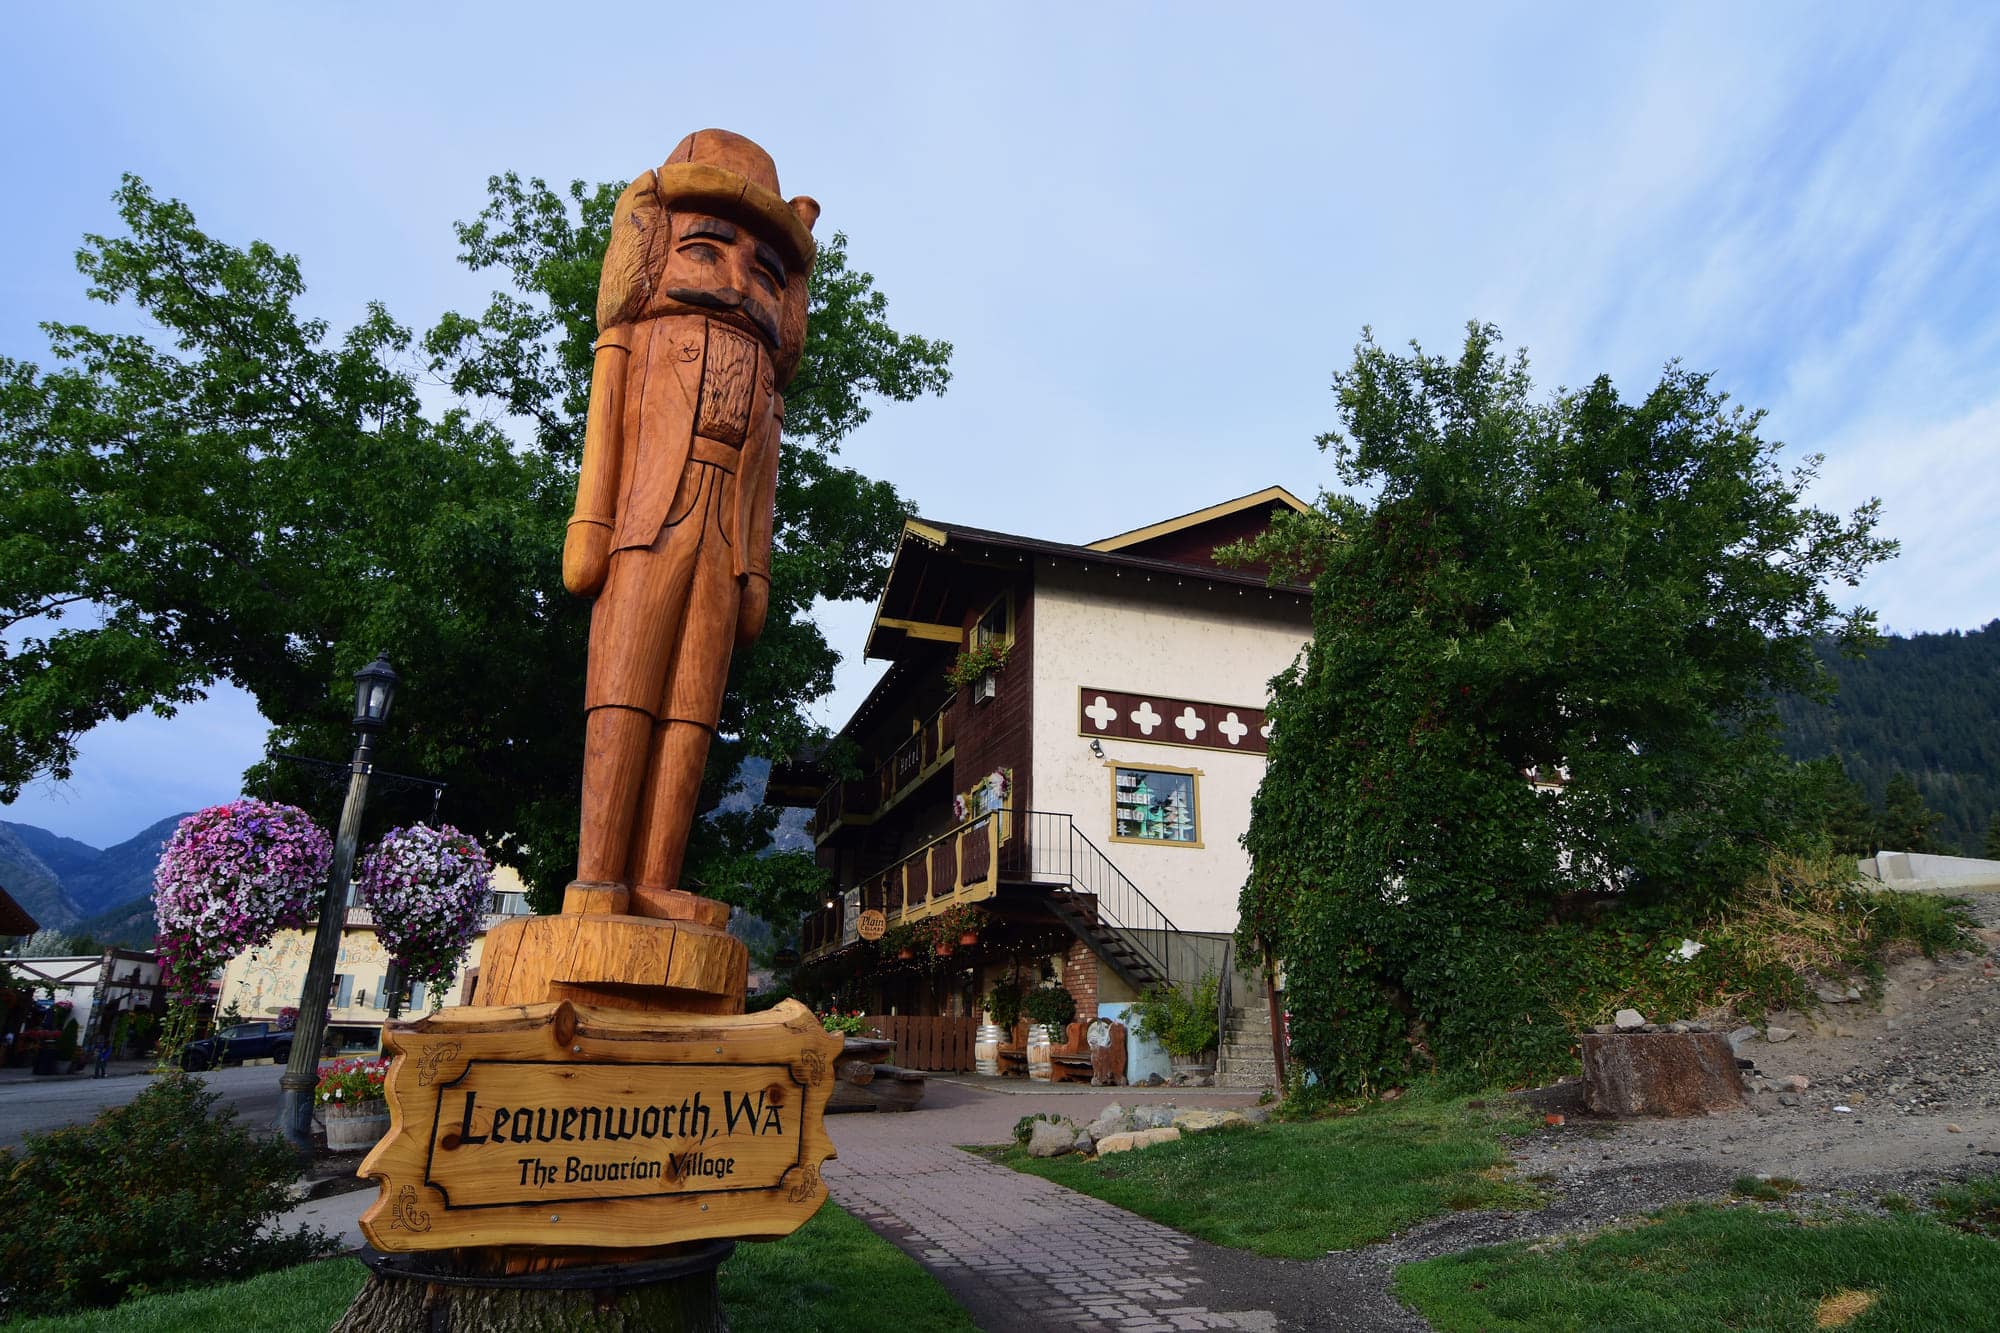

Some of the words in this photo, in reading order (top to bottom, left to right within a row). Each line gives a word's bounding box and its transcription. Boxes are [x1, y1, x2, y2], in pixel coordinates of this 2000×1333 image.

[862, 916, 885, 927] Plain
[460, 1090, 719, 1146] Leavenworth,
[723, 1090, 785, 1137] WA
[518, 1158, 558, 1190] The
[564, 1156, 662, 1184] Bavarian
[669, 1151, 735, 1180] Village
